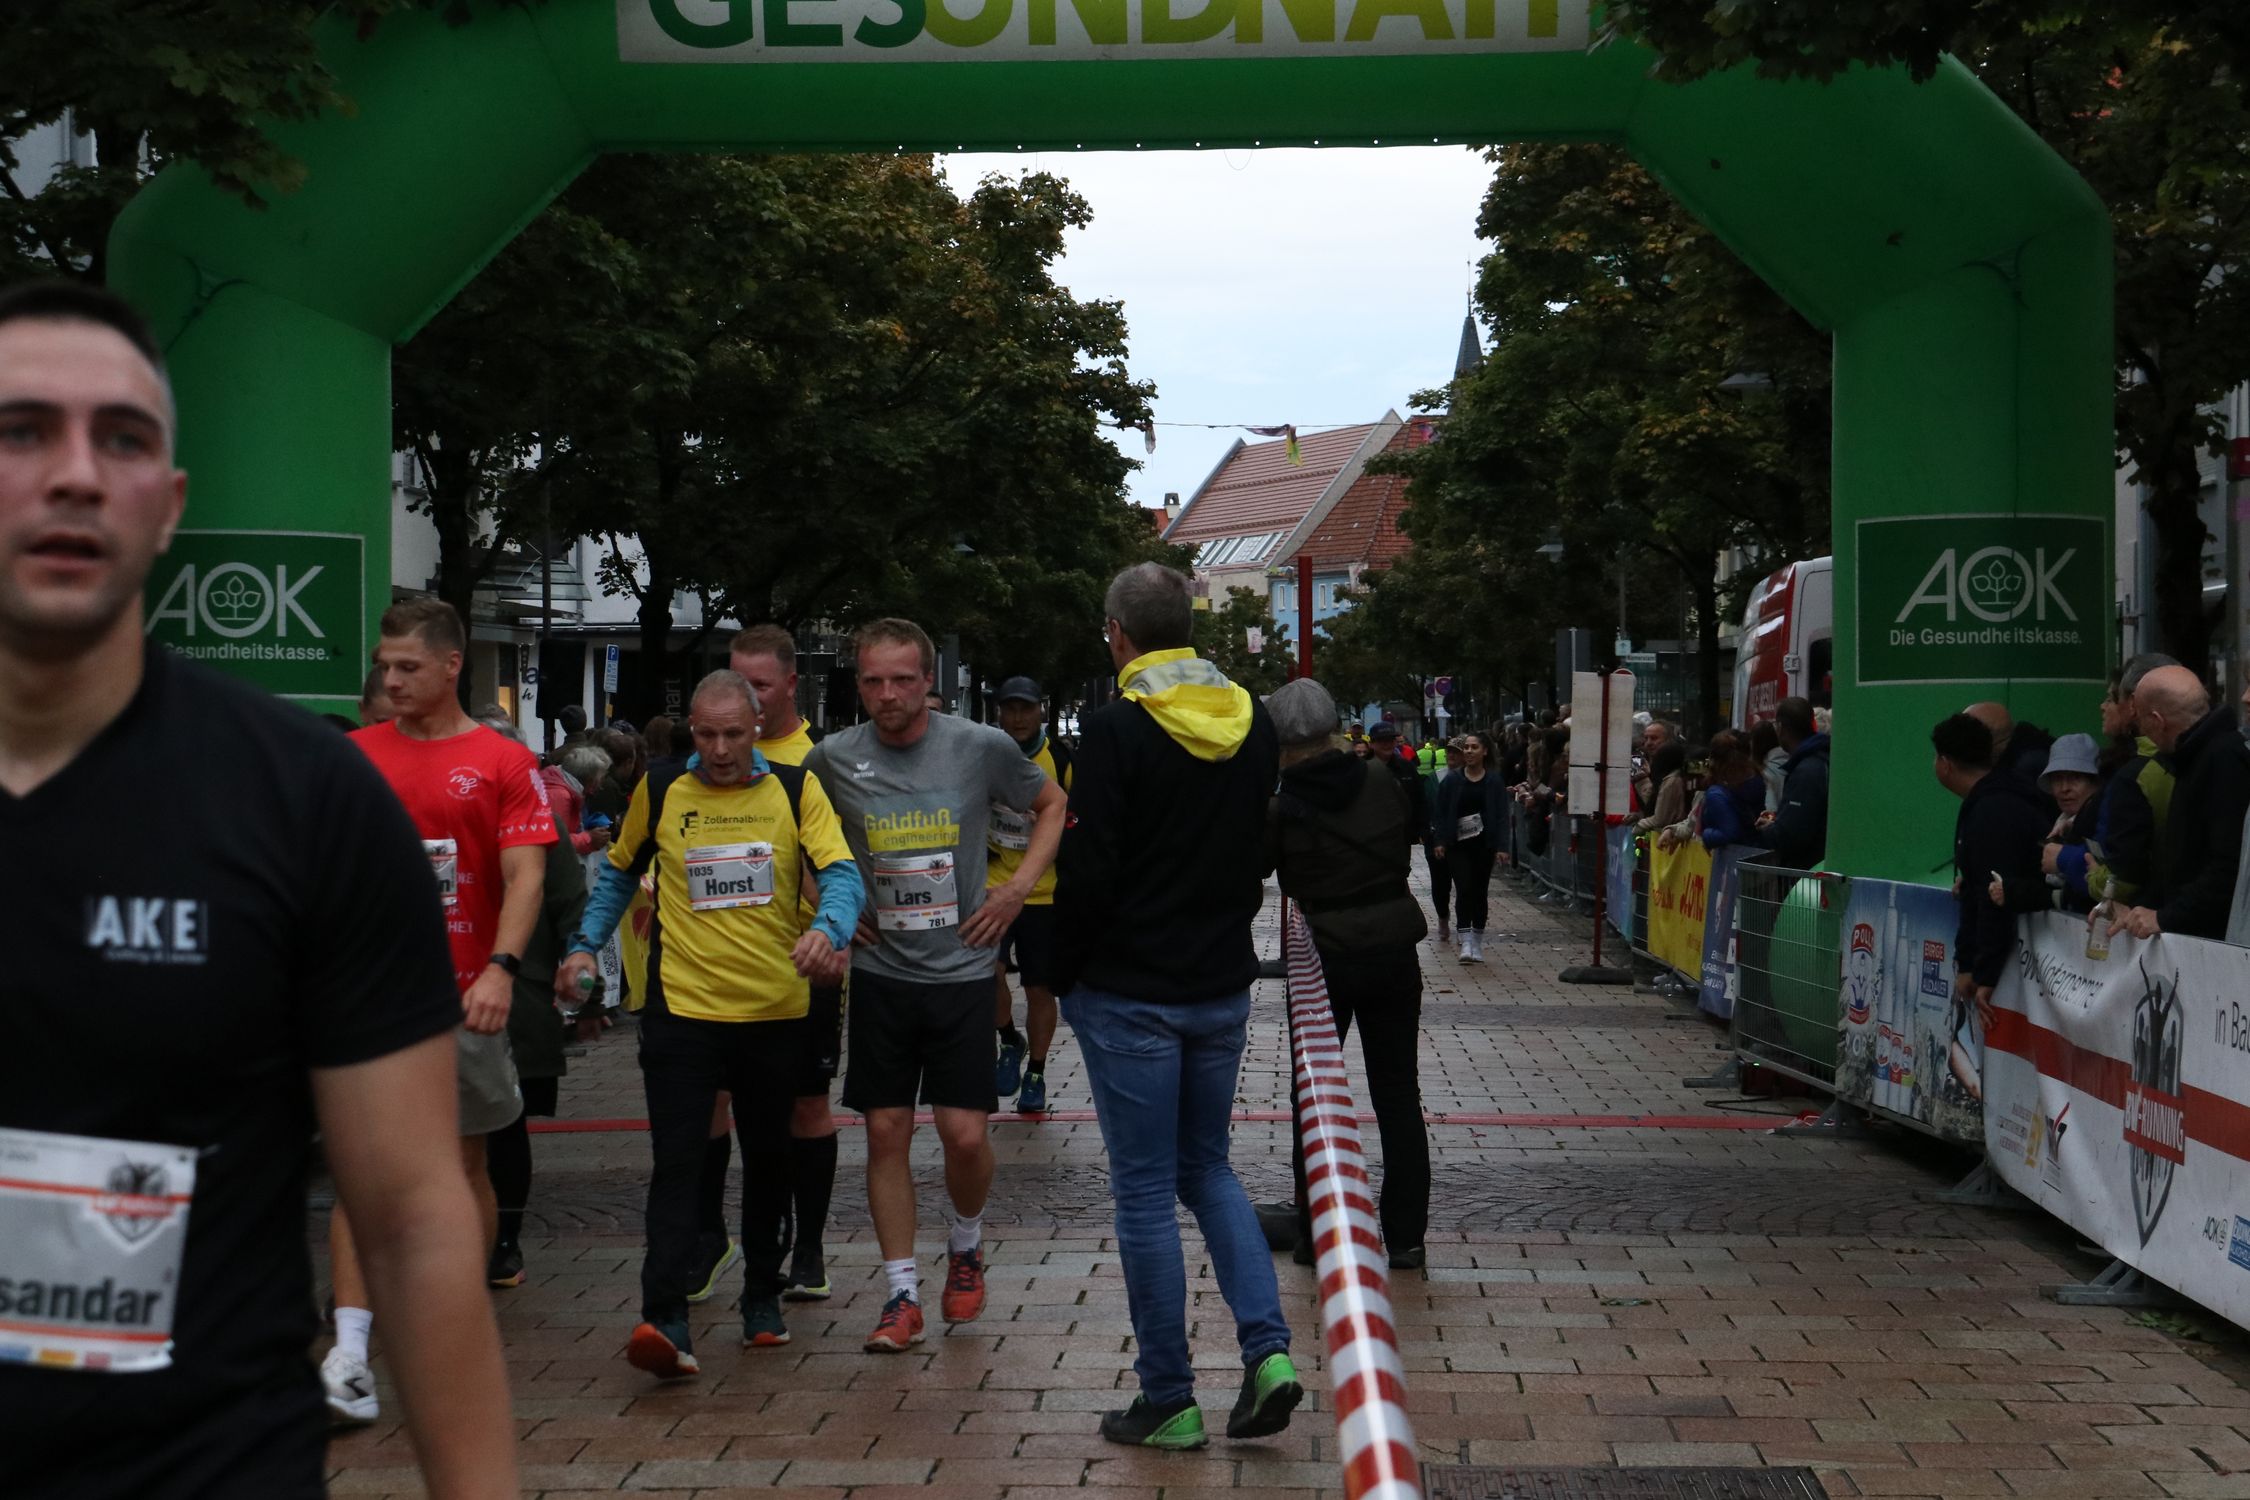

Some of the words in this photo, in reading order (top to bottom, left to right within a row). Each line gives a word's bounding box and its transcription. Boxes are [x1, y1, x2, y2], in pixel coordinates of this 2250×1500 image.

[1894, 545, 2079, 623] AOK
[145, 561, 326, 638] AOK
[1890, 629, 1916, 646] Die
[1920, 626, 2083, 646] Gesundheitskasse.
[703, 815, 776, 825] Zollernalbkreis
[864, 808, 951, 832] Goldfuß
[883, 830, 959, 848] engineering
[688, 866, 714, 877] 1035
[876, 876, 891, 887] 781
[705, 876, 755, 896] Horst
[895, 889, 932, 905] Lars
[88, 894, 198, 951] AKE
[929, 917, 946, 927] 781
[2214, 995, 2227, 1045] in
[2125, 1088, 2185, 1152] BW-RUNNING
[2202, 1215, 2220, 1245] AOK
